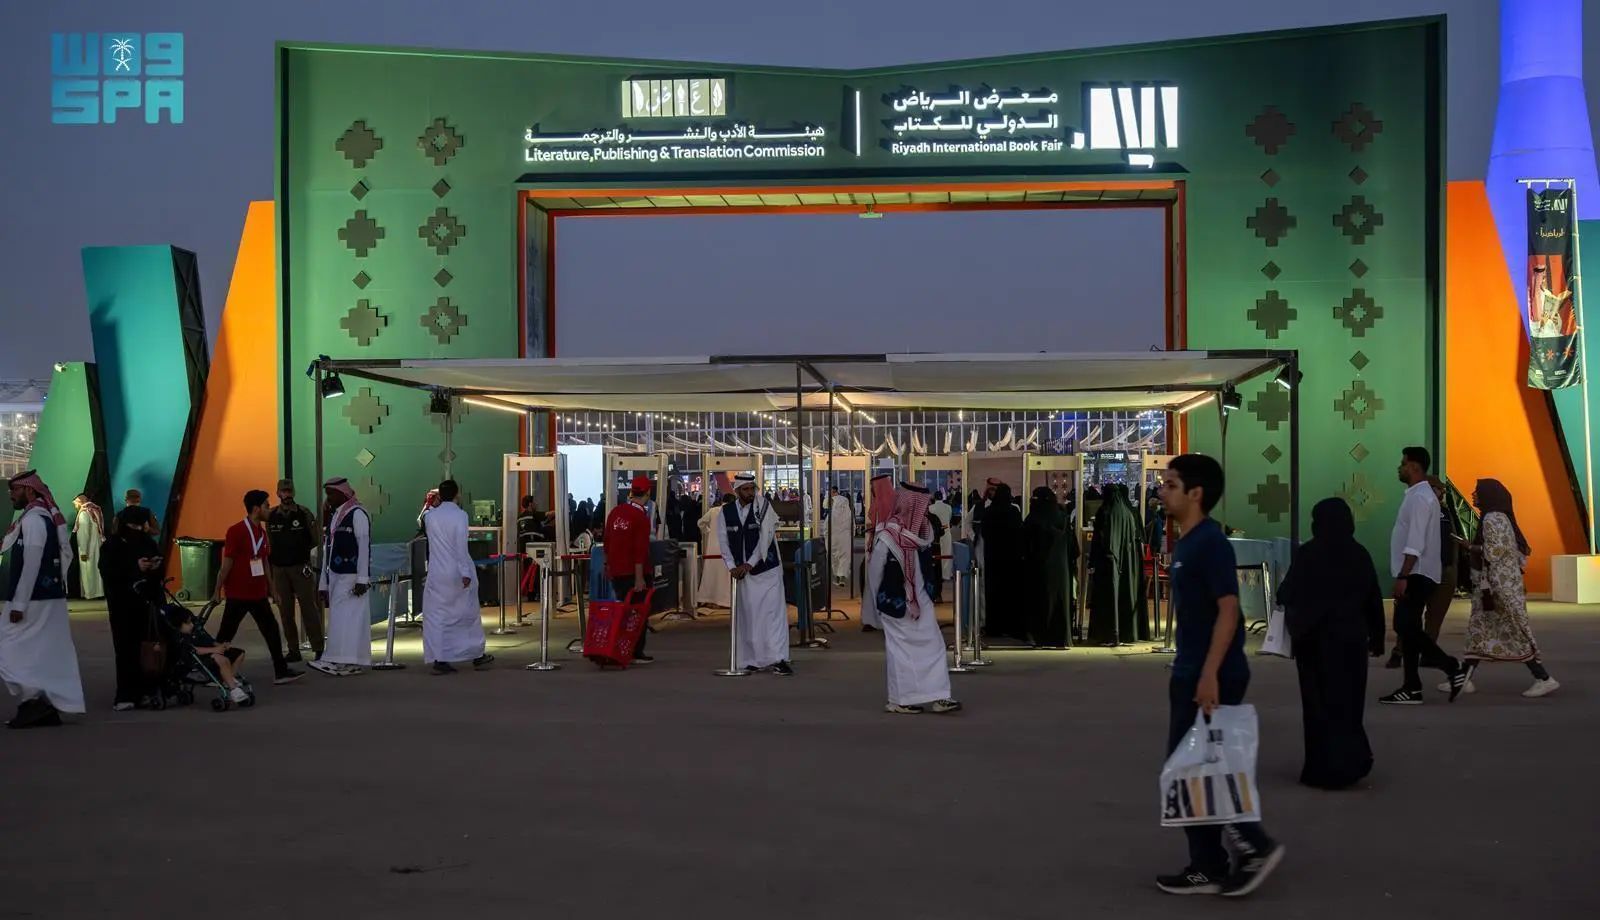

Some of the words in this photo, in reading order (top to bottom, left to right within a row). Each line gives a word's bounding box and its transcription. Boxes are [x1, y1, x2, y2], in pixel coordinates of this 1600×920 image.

[893, 90, 970, 112] الرياض
[973, 88, 1058, 110] معرض
[719, 123, 746, 142] الأدب
[747, 124, 825, 141] هيئة
[893, 115, 973, 136] للكتاب
[977, 114, 1058, 139] الدولي
[524, 129, 625, 144] والترجمة
[625, 127, 718, 143] والنشر
[594, 147, 658, 162] Publishing
[660, 147, 671, 159] &
[671, 145, 743, 159] Translation
[743, 144, 825, 158] Commission
[892, 141, 931, 155] Riyadh
[932, 141, 1007, 153] International
[1009, 140, 1038, 152] Book
[1042, 139, 1063, 151] Fair
